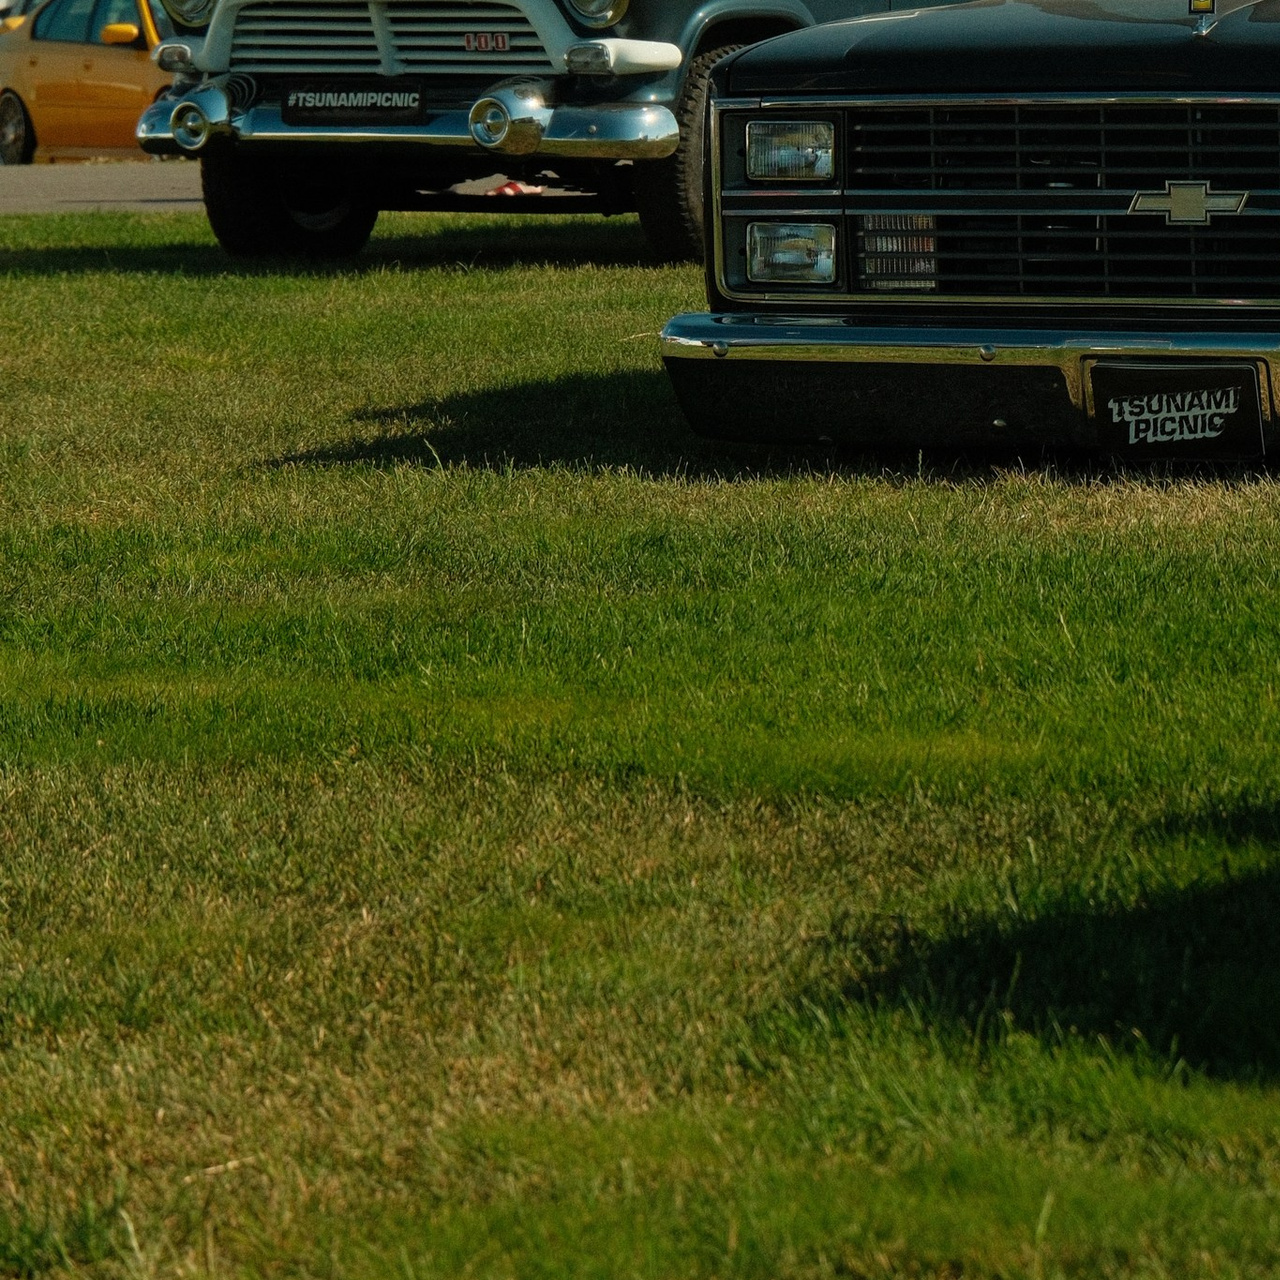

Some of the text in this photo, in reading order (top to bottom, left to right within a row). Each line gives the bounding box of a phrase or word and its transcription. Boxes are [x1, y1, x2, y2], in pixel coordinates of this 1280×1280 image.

[464, 33, 510, 52] 100
[287, 91, 420, 109] #TSUNAMIPICNIC
[1108, 386, 1242, 423] TSUNAMI
[1129, 412, 1226, 445] PICNIC
